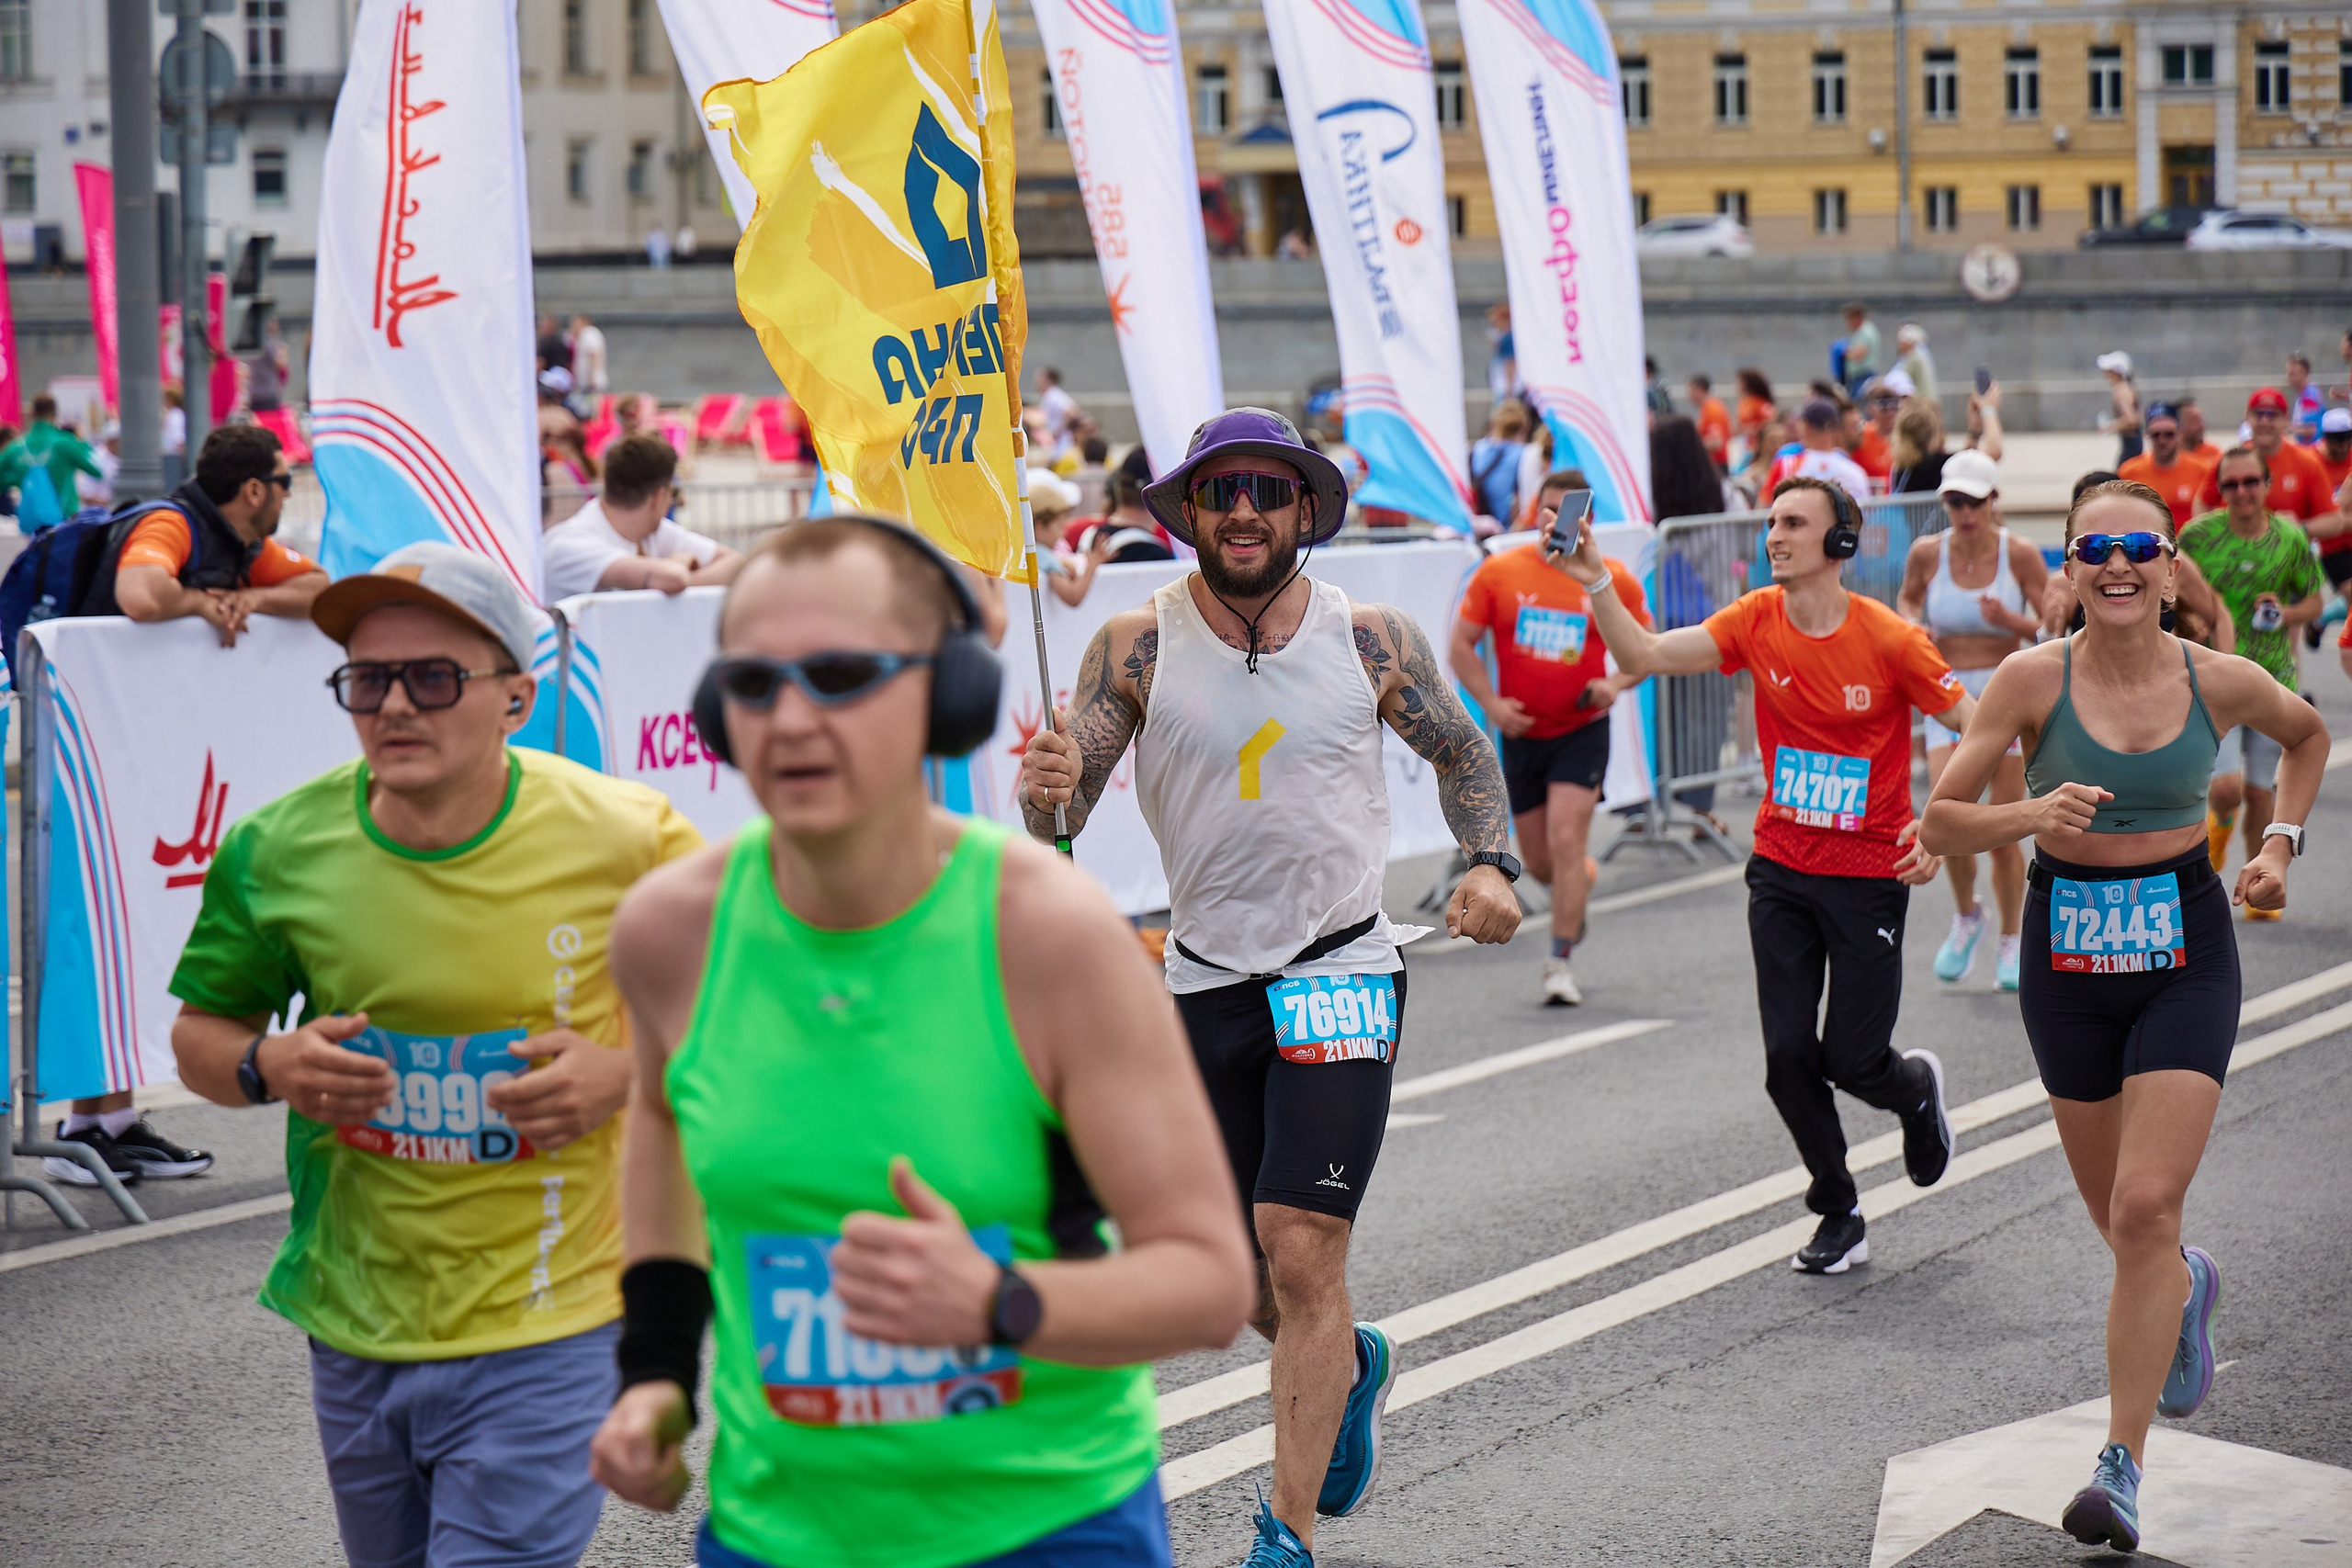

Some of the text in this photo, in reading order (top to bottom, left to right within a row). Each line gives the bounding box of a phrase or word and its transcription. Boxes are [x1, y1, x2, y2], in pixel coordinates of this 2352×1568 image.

[1842, 683, 1871, 711] 10
[1781, 768, 1860, 812] 74707
[2063, 889, 2077, 898] ПСБ
[2102, 885, 2124, 905] 10
[2058, 902, 2173, 951] 72443
[2091, 953, 2143, 973] 21.1KM
[1282, 980, 1300, 990] ПСБ
[1283, 988, 1389, 1040] 76914
[409, 1042, 441, 1067] 10
[1324, 1037, 1388, 1063] 21.1KM D
[391, 1133, 469, 1164] 21.1KM
[481, 1131, 513, 1158] D
[1316, 1178, 1350, 1191] JÖGEL
